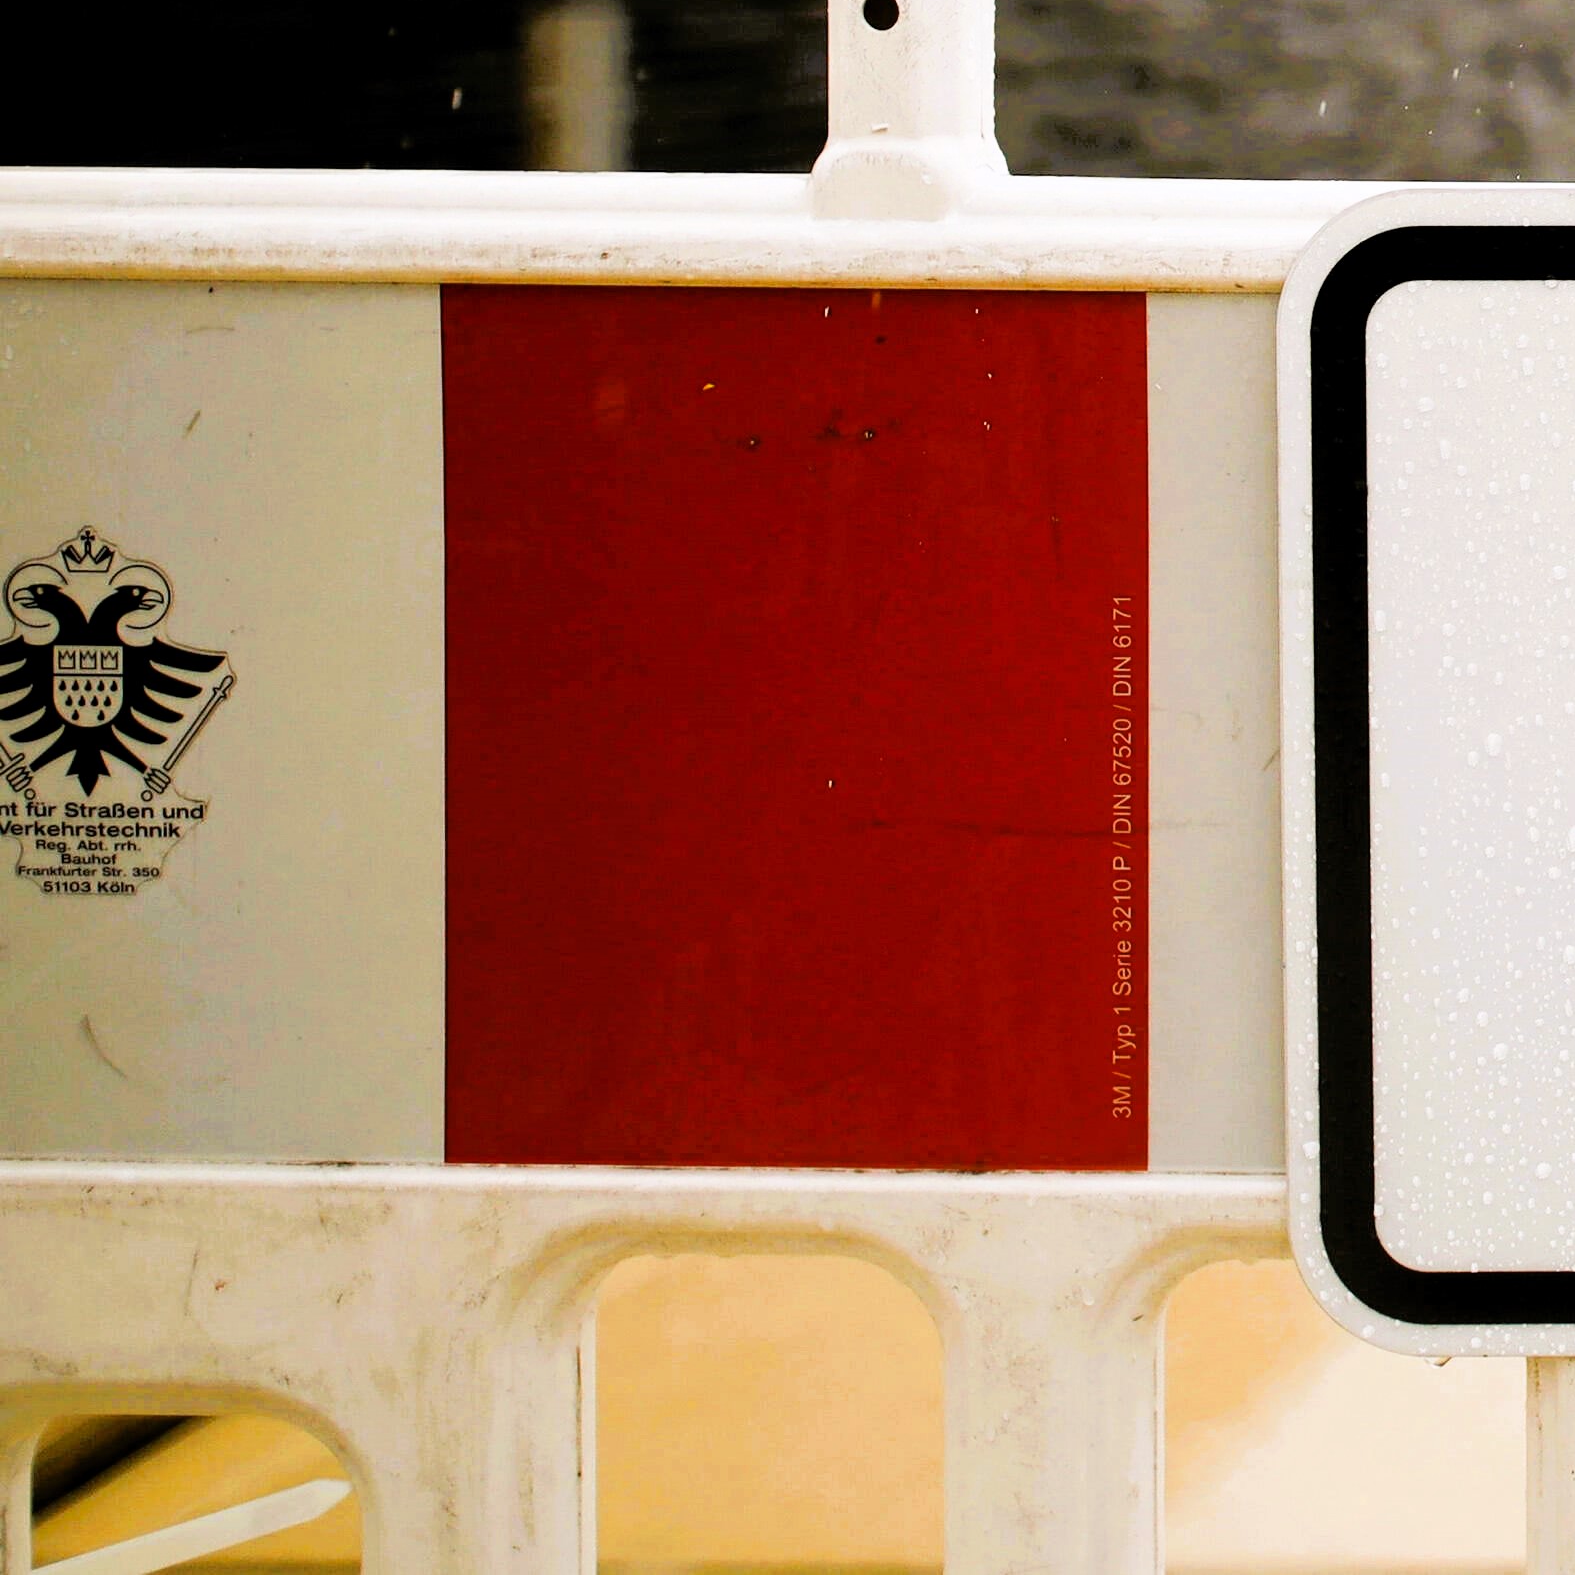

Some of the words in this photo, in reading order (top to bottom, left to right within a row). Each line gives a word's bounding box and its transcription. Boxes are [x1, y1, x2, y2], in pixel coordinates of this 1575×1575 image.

[1112, 597, 1132, 649] 6171
[1112, 656, 1132, 697] DIN
[1112, 704, 1132, 712] /
[1112, 718, 1132, 786] 67520
[25, 801, 57, 817] für
[64, 802, 154, 818] Straßen
[162, 804, 204, 819] und
[1112, 794, 1132, 834] DIN
[0, 820, 181, 838] Verkehrstechnik
[35, 840, 71, 853] Reg.
[77, 840, 108, 851] Abt.
[114, 841, 142, 851] rrh.
[1112, 841, 1132, 849] /
[61, 853, 117, 865] Bauhof
[1112, 855, 1132, 871] P
[18, 866, 97, 876] Frankfurter
[102, 867, 127, 877] Str.
[132, 867, 160, 877] 350
[43, 881, 91, 893] 51103
[97, 881, 135, 893] Köln
[1112, 879, 1132, 932] 3210
[1112, 940, 1132, 996] Serie
[1112, 1007, 1132, 1015] 1
[1112, 1024, 1137, 1065] Typ
[1112, 1086, 1132, 1119] 3M
